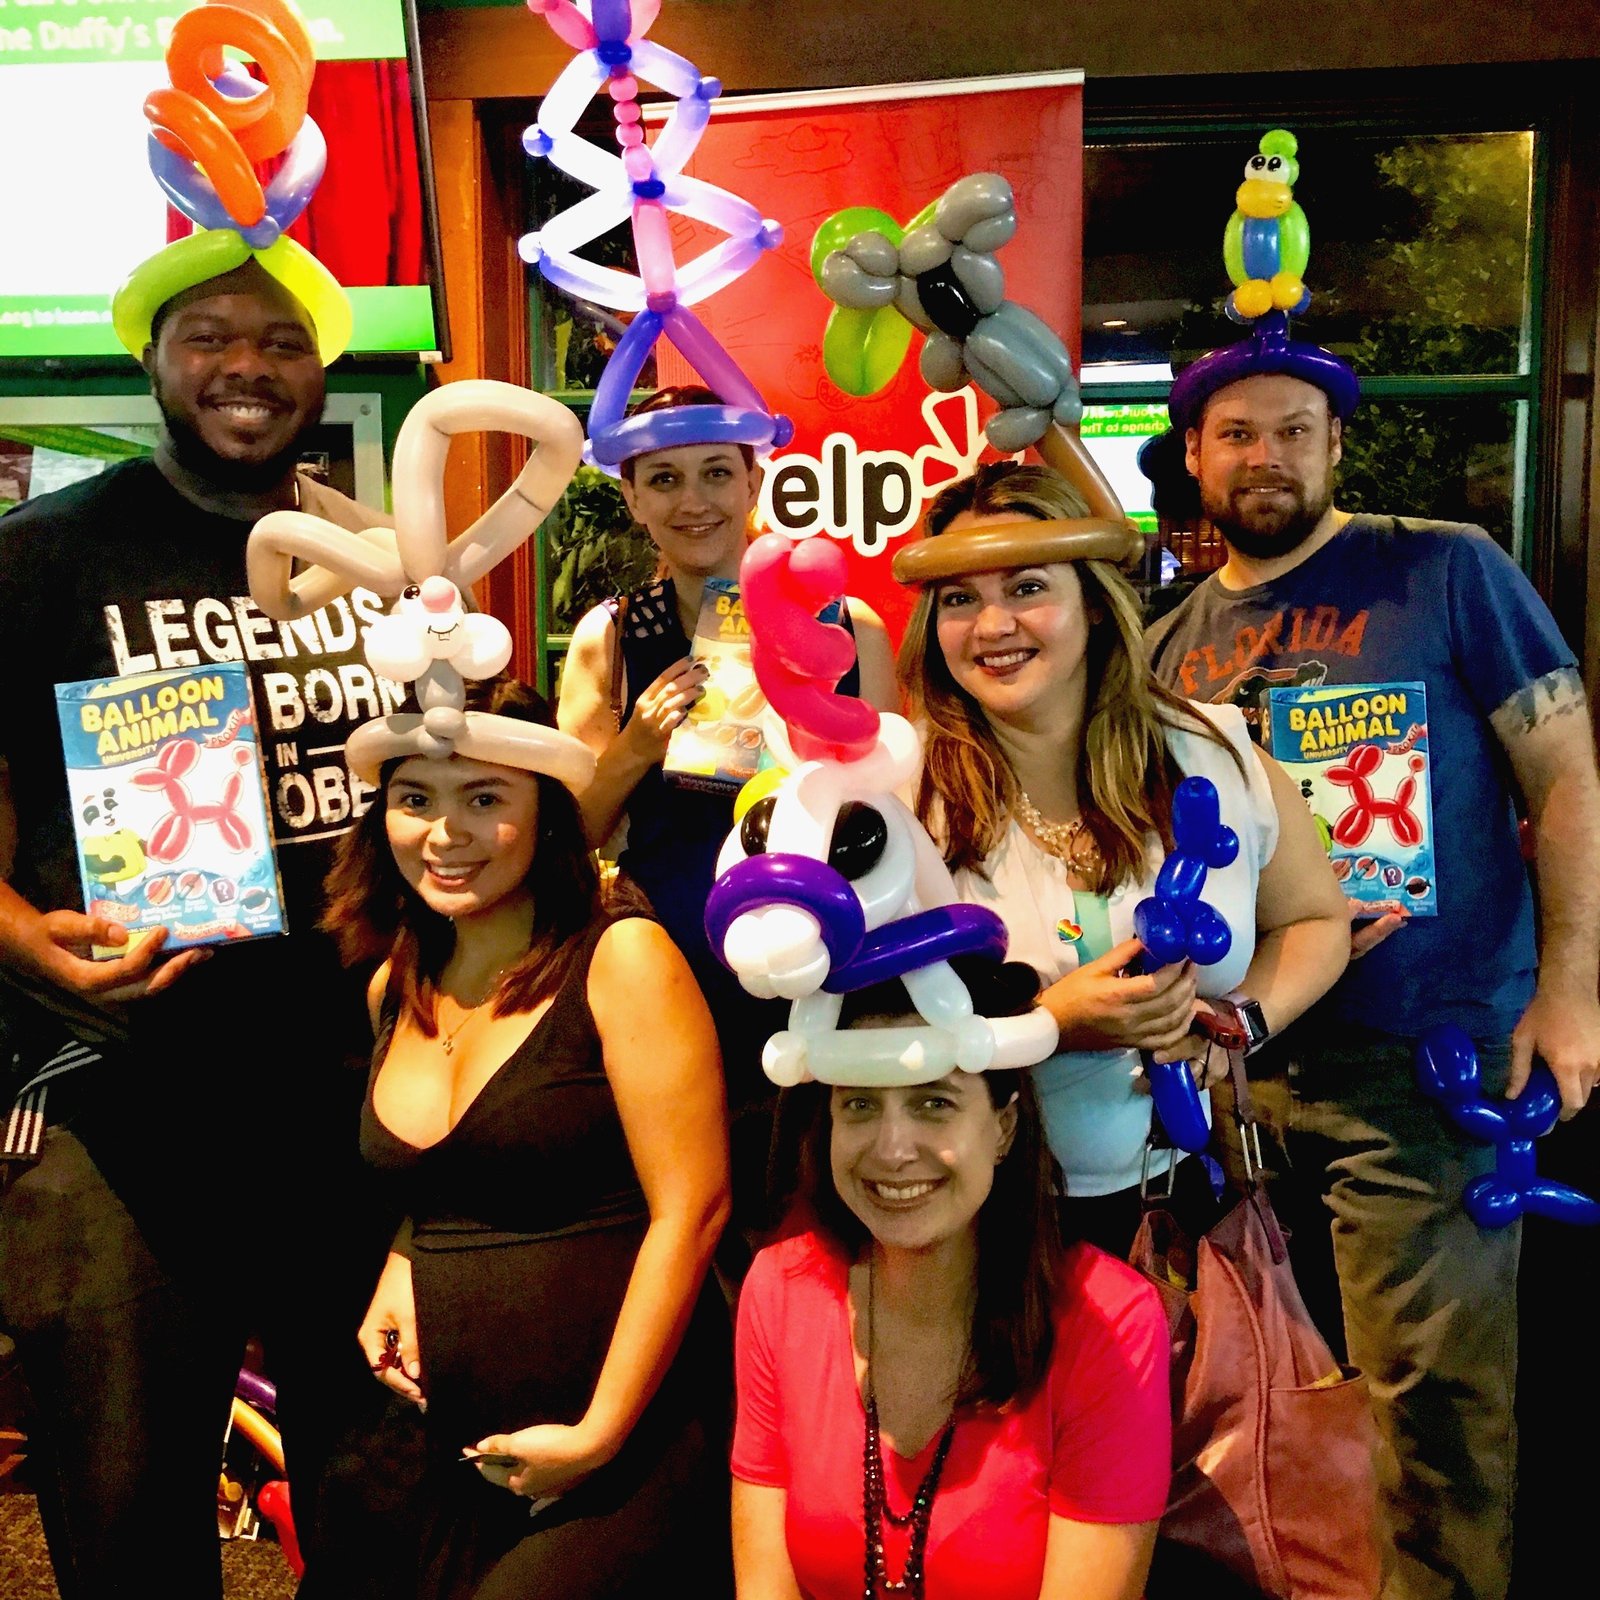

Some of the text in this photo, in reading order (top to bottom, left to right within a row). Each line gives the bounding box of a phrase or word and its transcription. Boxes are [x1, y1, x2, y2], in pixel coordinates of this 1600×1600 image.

[38, 16, 151, 54] Duffy's
[772, 443, 912, 546] elp
[103, 586, 388, 677] LEGENDS
[1179, 604, 1370, 695] FLORIDA
[80, 675, 225, 733] BALLOON
[263, 663, 407, 731] BORN
[1289, 693, 1406, 731] BALLOON
[97, 702, 220, 756] ANIMAL
[1300, 715, 1401, 752] ANIMAL
[102, 743, 158, 766] UNIVERSITY
[276, 742, 299, 768] IN
[1304, 745, 1349, 760] UNIVERSITY
